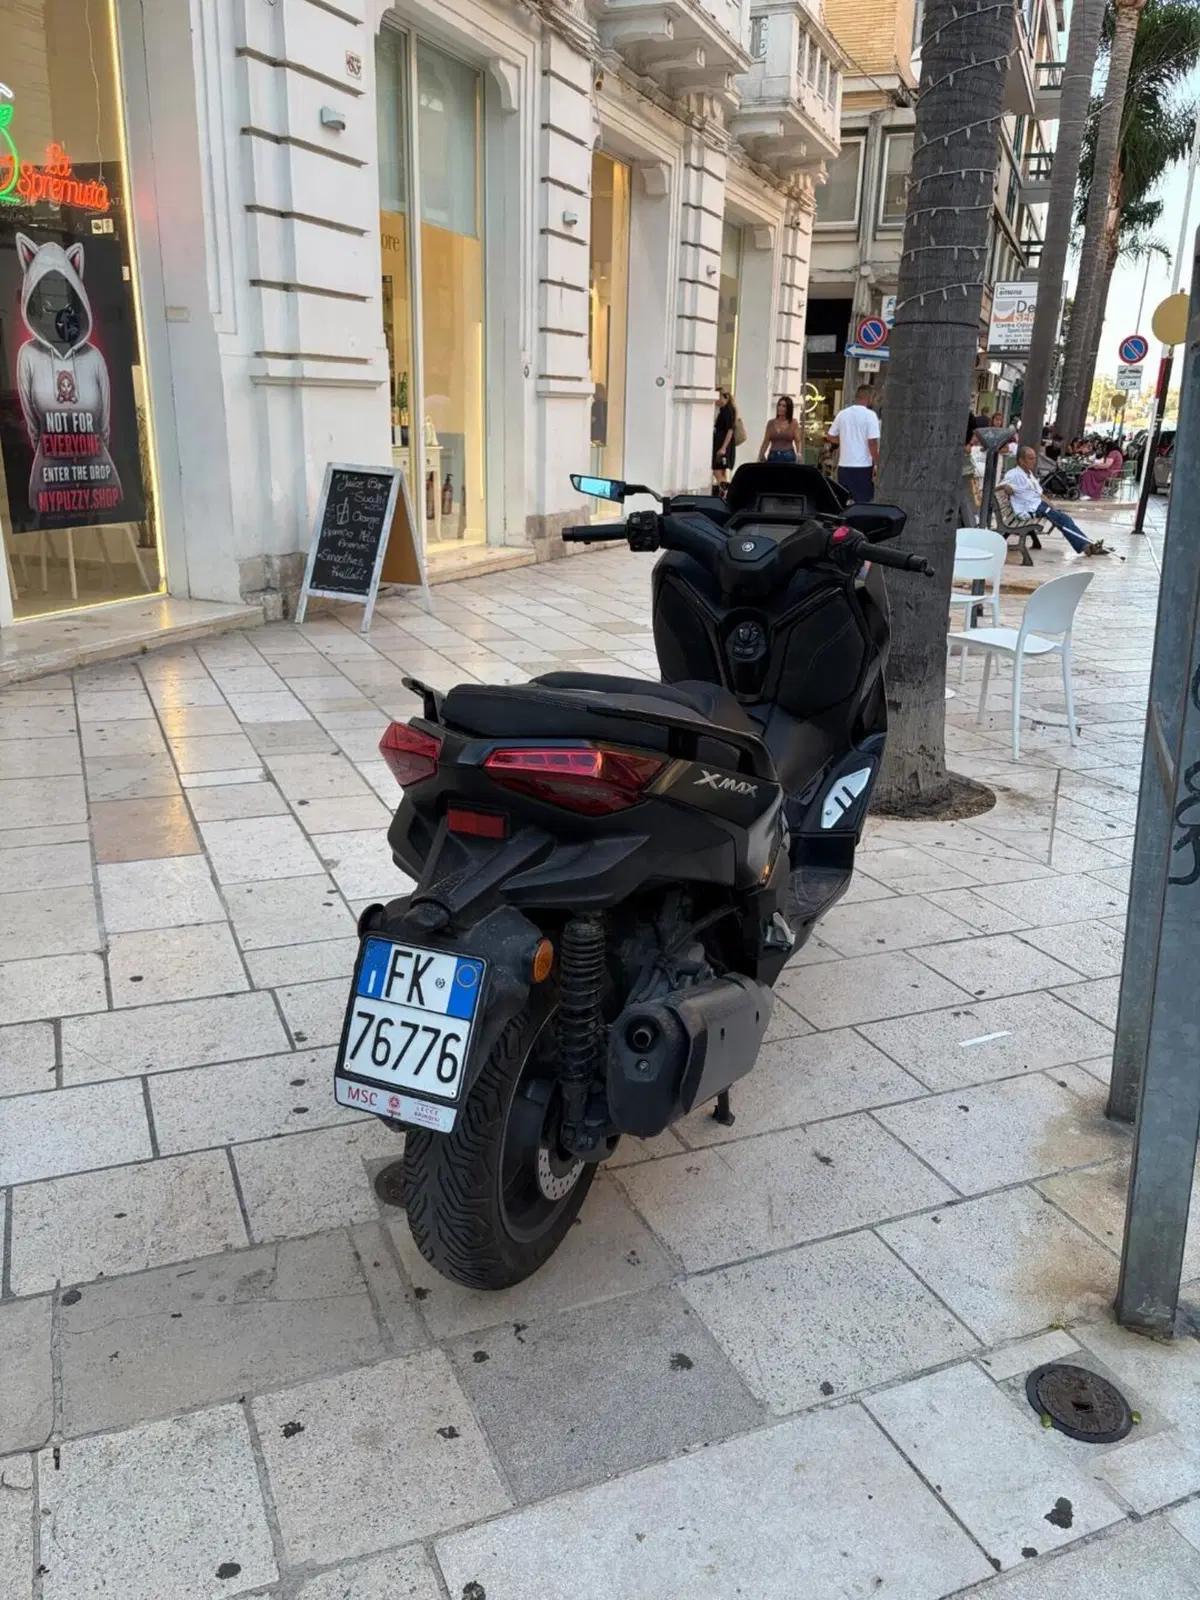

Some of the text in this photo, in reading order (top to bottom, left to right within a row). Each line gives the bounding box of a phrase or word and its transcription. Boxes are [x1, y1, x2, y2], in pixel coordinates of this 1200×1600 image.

[17, 161, 110, 211] Spremuta
[1016, 300, 1036, 313] De
[45, 411, 94, 433] NOT FOR
[41, 433, 101, 457] EVERYONE
[43, 464, 111, 483] ENTER THE DROP
[38, 487, 120, 512] MYPUZZY.SHOP
[693, 769, 759, 798] XMAX
[385, 949, 435, 1006] FK
[350, 1011, 462, 1084] 76776
[348, 1086, 378, 1106] MSC
